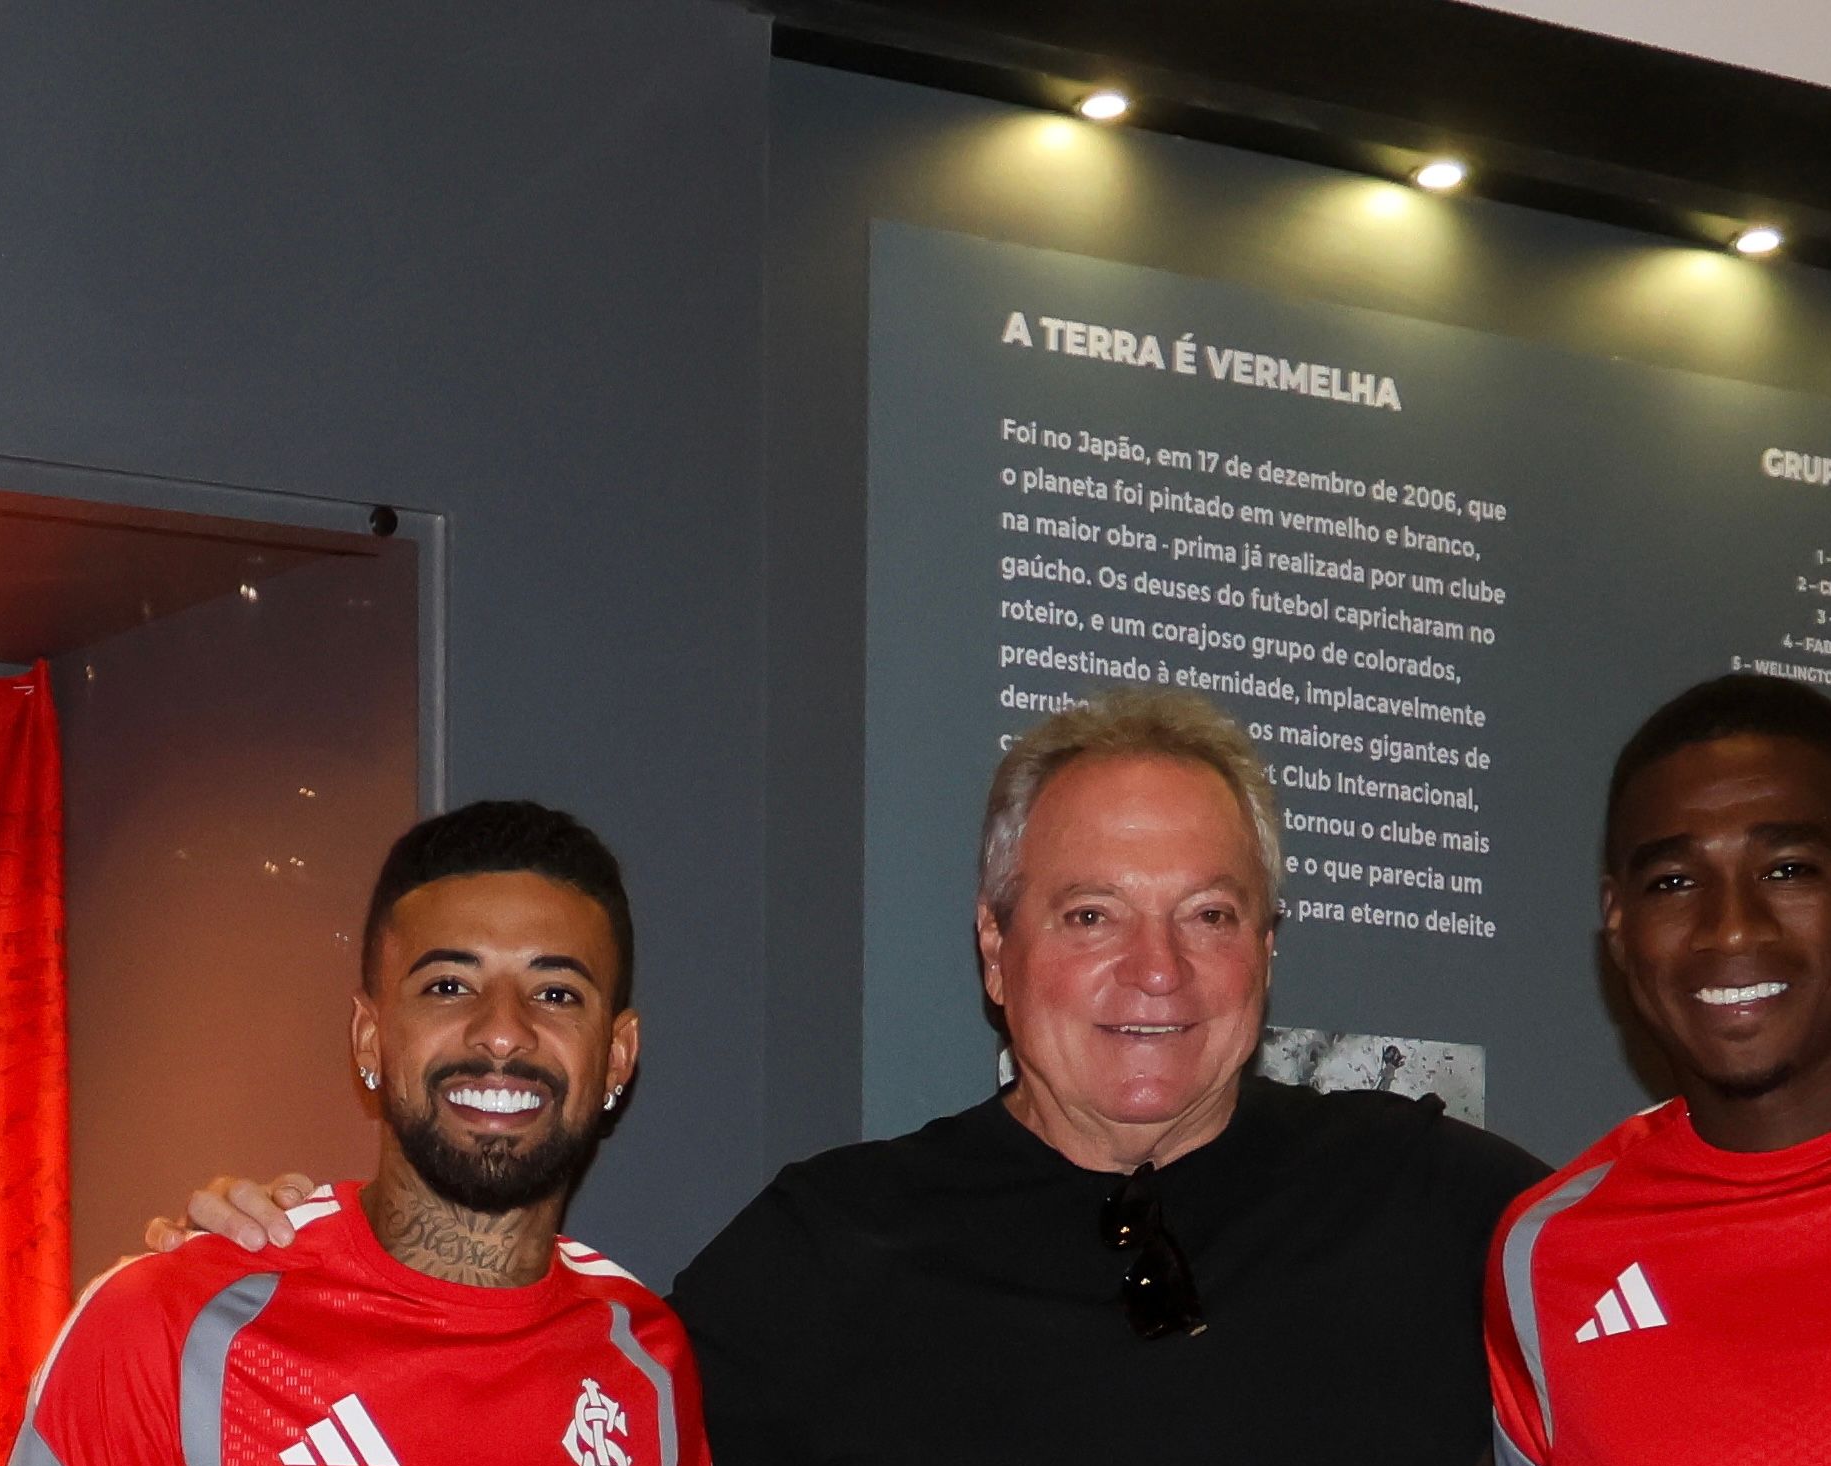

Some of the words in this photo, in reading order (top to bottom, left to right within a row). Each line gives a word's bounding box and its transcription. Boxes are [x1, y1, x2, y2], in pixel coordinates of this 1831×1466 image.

[1001, 312, 1033, 347] A
[1039, 317, 1166, 369] TERRA
[1173, 333, 1197, 374] É
[1205, 346, 1401, 411] VERMELHA
[1001, 419, 1036, 444] Foi
[1041, 430, 1071, 450] no
[1077, 431, 1151, 466] Japão,
[1156, 449, 1191, 470] em
[1196, 450, 1219, 473] 17
[1225, 455, 1252, 479] de
[1256, 460, 1366, 497] dezembro
[1370, 479, 1398, 503] de
[1402, 484, 1462, 516] 2006,
[1466, 500, 1506, 522] que
[1000, 468, 1016, 485] o
[1023, 467, 1107, 500] planeta
[1113, 479, 1143, 505] foi
[1149, 487, 1234, 519] pintado
[1239, 505, 1274, 526] em
[1279, 511, 1379, 542] vermelho
[1385, 529, 1398, 545] e
[1402, 525, 1480, 562] branco,
[1002, 512, 1028, 532] na
[1036, 516, 1101, 542] maior
[1106, 524, 1156, 551] obra
[1172, 535, 1236, 563] prima
[1241, 542, 1262, 571] já
[1267, 552, 1364, 583] realizada
[1371, 569, 1406, 589] por
[1410, 575, 1444, 595] um
[1448, 577, 1505, 605] clube
[1001, 554, 1091, 585] gaúcho.
[1098, 567, 1127, 590] Os
[1132, 571, 1211, 602] deuses
[1215, 584, 1245, 607] do
[1251, 587, 1328, 620] futebol
[1334, 606, 1463, 640] capricharam
[1469, 626, 1495, 645] no
[1796, 576, 1807, 591] 2
[1817, 609, 1825, 624] 3
[1002, 600, 1084, 631] roteiro,
[1091, 614, 1104, 631] e
[1111, 616, 1145, 638] um
[1152, 622, 1246, 651] corajoso
[1252, 636, 1315, 663] grupo
[1321, 642, 1348, 666] de
[1354, 649, 1461, 684] colorados,
[1782, 634, 1792, 648] 4
[1001, 645, 1150, 681] predestinado
[1157, 660, 1169, 683] à
[1176, 666, 1300, 704] eternidade,
[1307, 681, 1486, 727] implacavelmente
[1248, 722, 1273, 740] os
[1280, 725, 1363, 753] maiores
[1370, 734, 1459, 765] gigantes
[1465, 747, 1490, 769] de
[1283, 765, 1331, 791] Club
[1338, 772, 1479, 813] Internacional,
[1284, 808, 1355, 837] tornou
[1360, 822, 1374, 839] o
[1380, 820, 1436, 846] clube
[1443, 831, 1489, 853] mais
[1286, 856, 1299, 873] e
[1305, 858, 1317, 875] o
[1323, 860, 1363, 883] que
[1369, 865, 1444, 890] parecia
[1451, 875, 1482, 894] um
[1299, 900, 1344, 922] para
[1351, 903, 1419, 929] eterno
[1425, 909, 1496, 938] deleite
